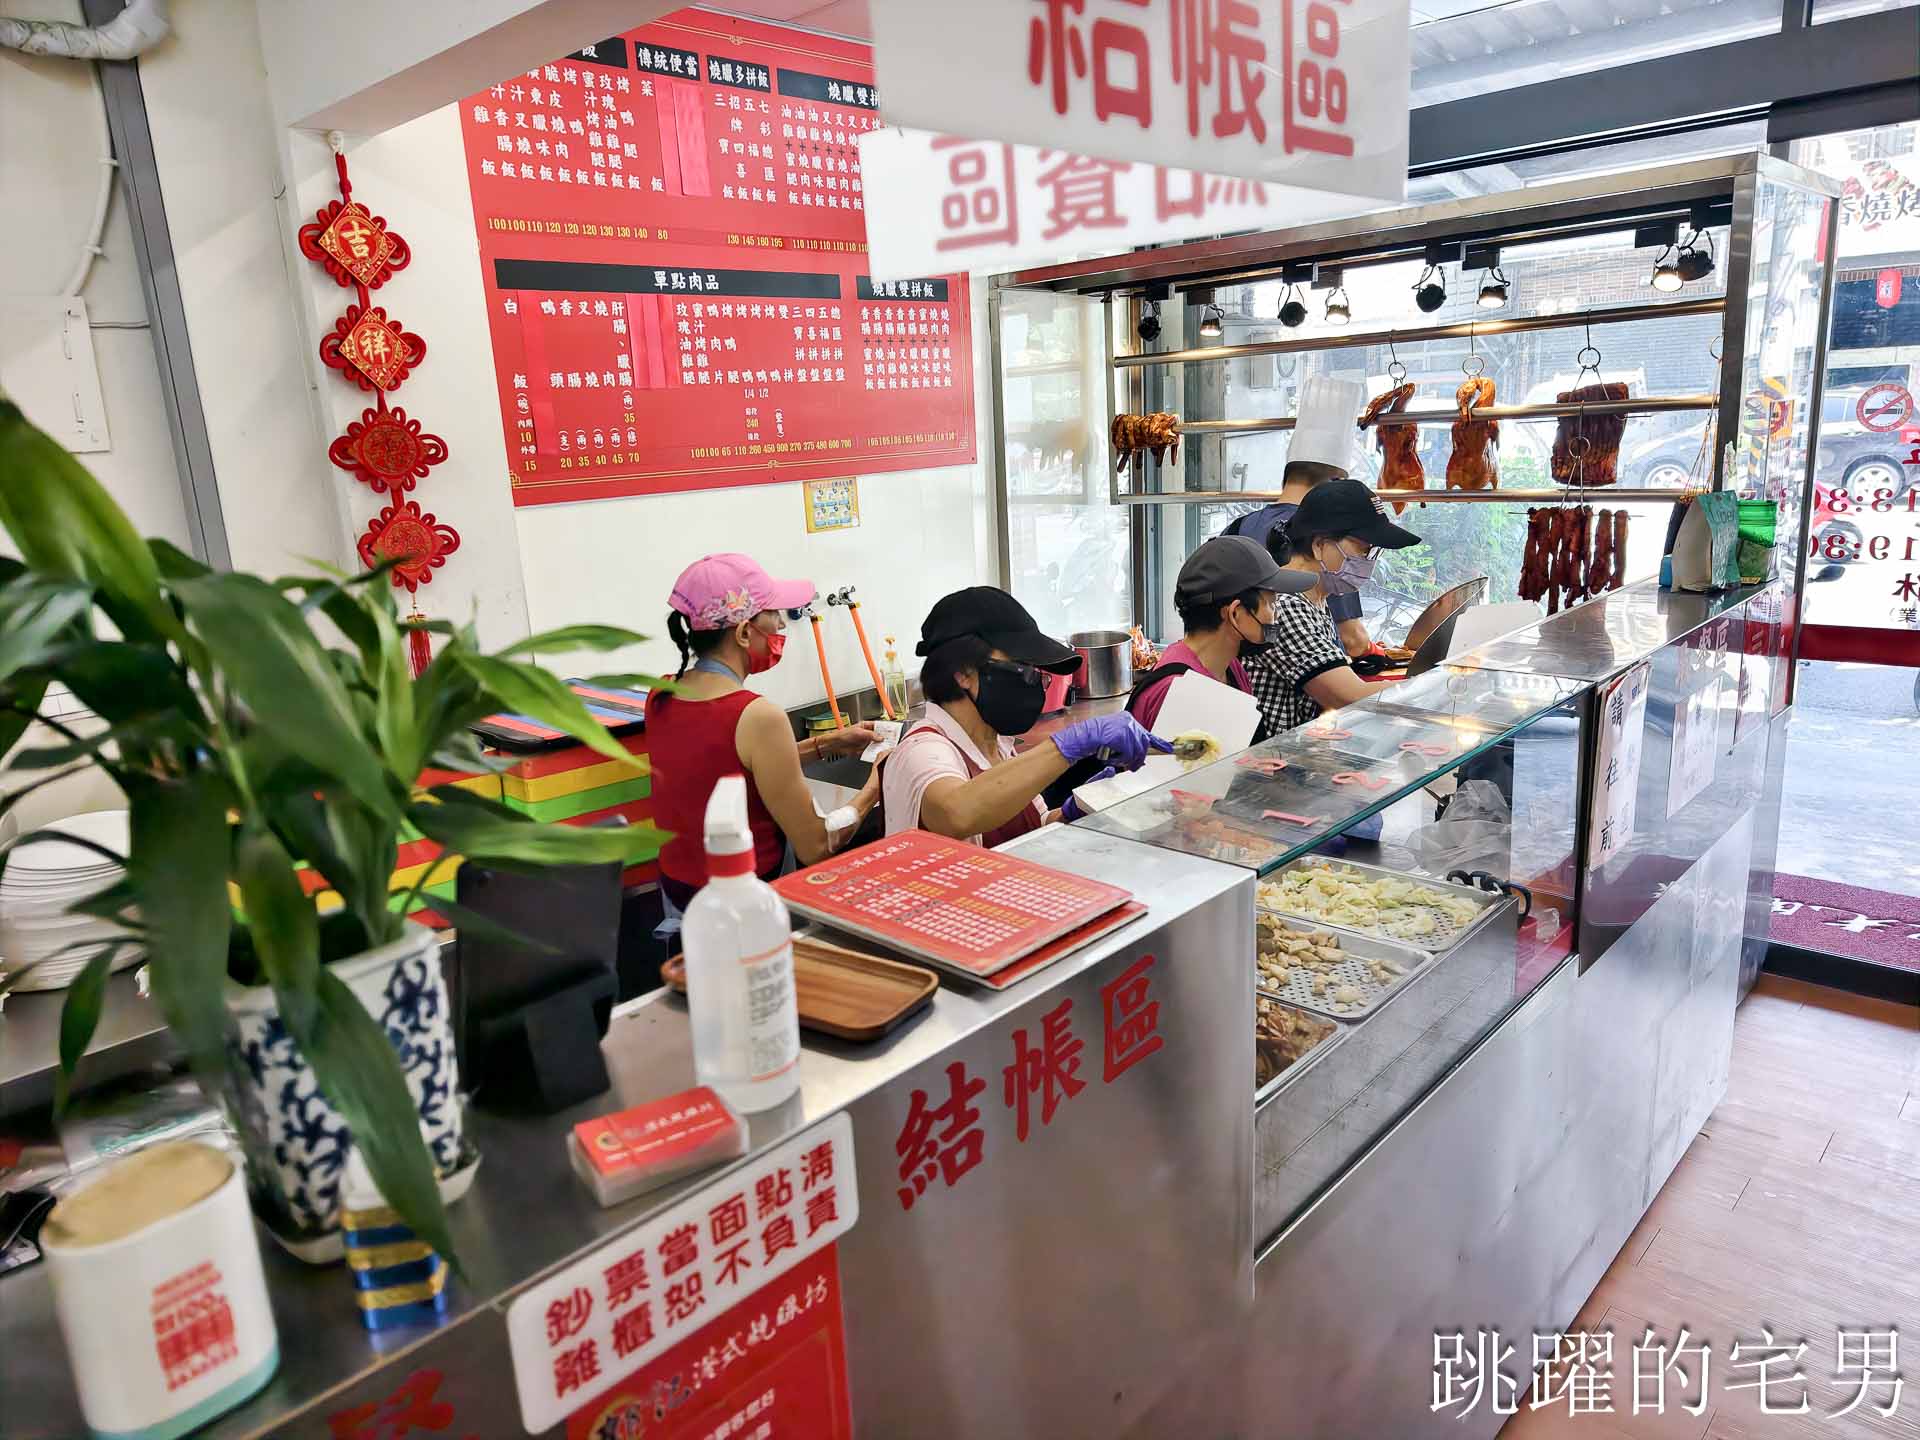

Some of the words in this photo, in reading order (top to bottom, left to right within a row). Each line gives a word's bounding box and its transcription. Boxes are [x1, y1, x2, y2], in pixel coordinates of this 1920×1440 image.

[638, 47, 698, 77] 傳統便當
[709, 59, 769, 88] 燒臘多拼飯
[491, 83, 517, 178] 汁香腸飯
[511, 84, 536, 180] 汁叉燒飯
[341, 219, 371, 259] 吉
[488, 217, 506, 230] 100
[507, 219, 526, 232] 100
[527, 220, 543, 233] 110
[545, 222, 561, 233] 120
[563, 223, 579, 235] 120
[582, 224, 597, 236] 120
[600, 225, 614, 237] 130
[616, 226, 631, 238] 130
[633, 227, 648, 239] 140
[657, 229, 668, 240] 80
[654, 270, 720, 291] 單點肉品
[872, 279, 935, 298] 燒臘雙拼飯
[360, 329, 391, 364] 祥
[624, 412, 636, 424] 35
[521, 432, 532, 443] 10
[525, 460, 537, 471] 15
[560, 457, 572, 468] 20
[578, 456, 590, 467] 35
[595, 455, 607, 465] 40
[612, 453, 624, 464] 45
[628, 452, 640, 463] 70
[895, 953, 1165, 1211] 結帳區
[545, 1140, 834, 1346] 鈔票當面點清
[553, 1185, 839, 1399] 離櫃恕不負責
